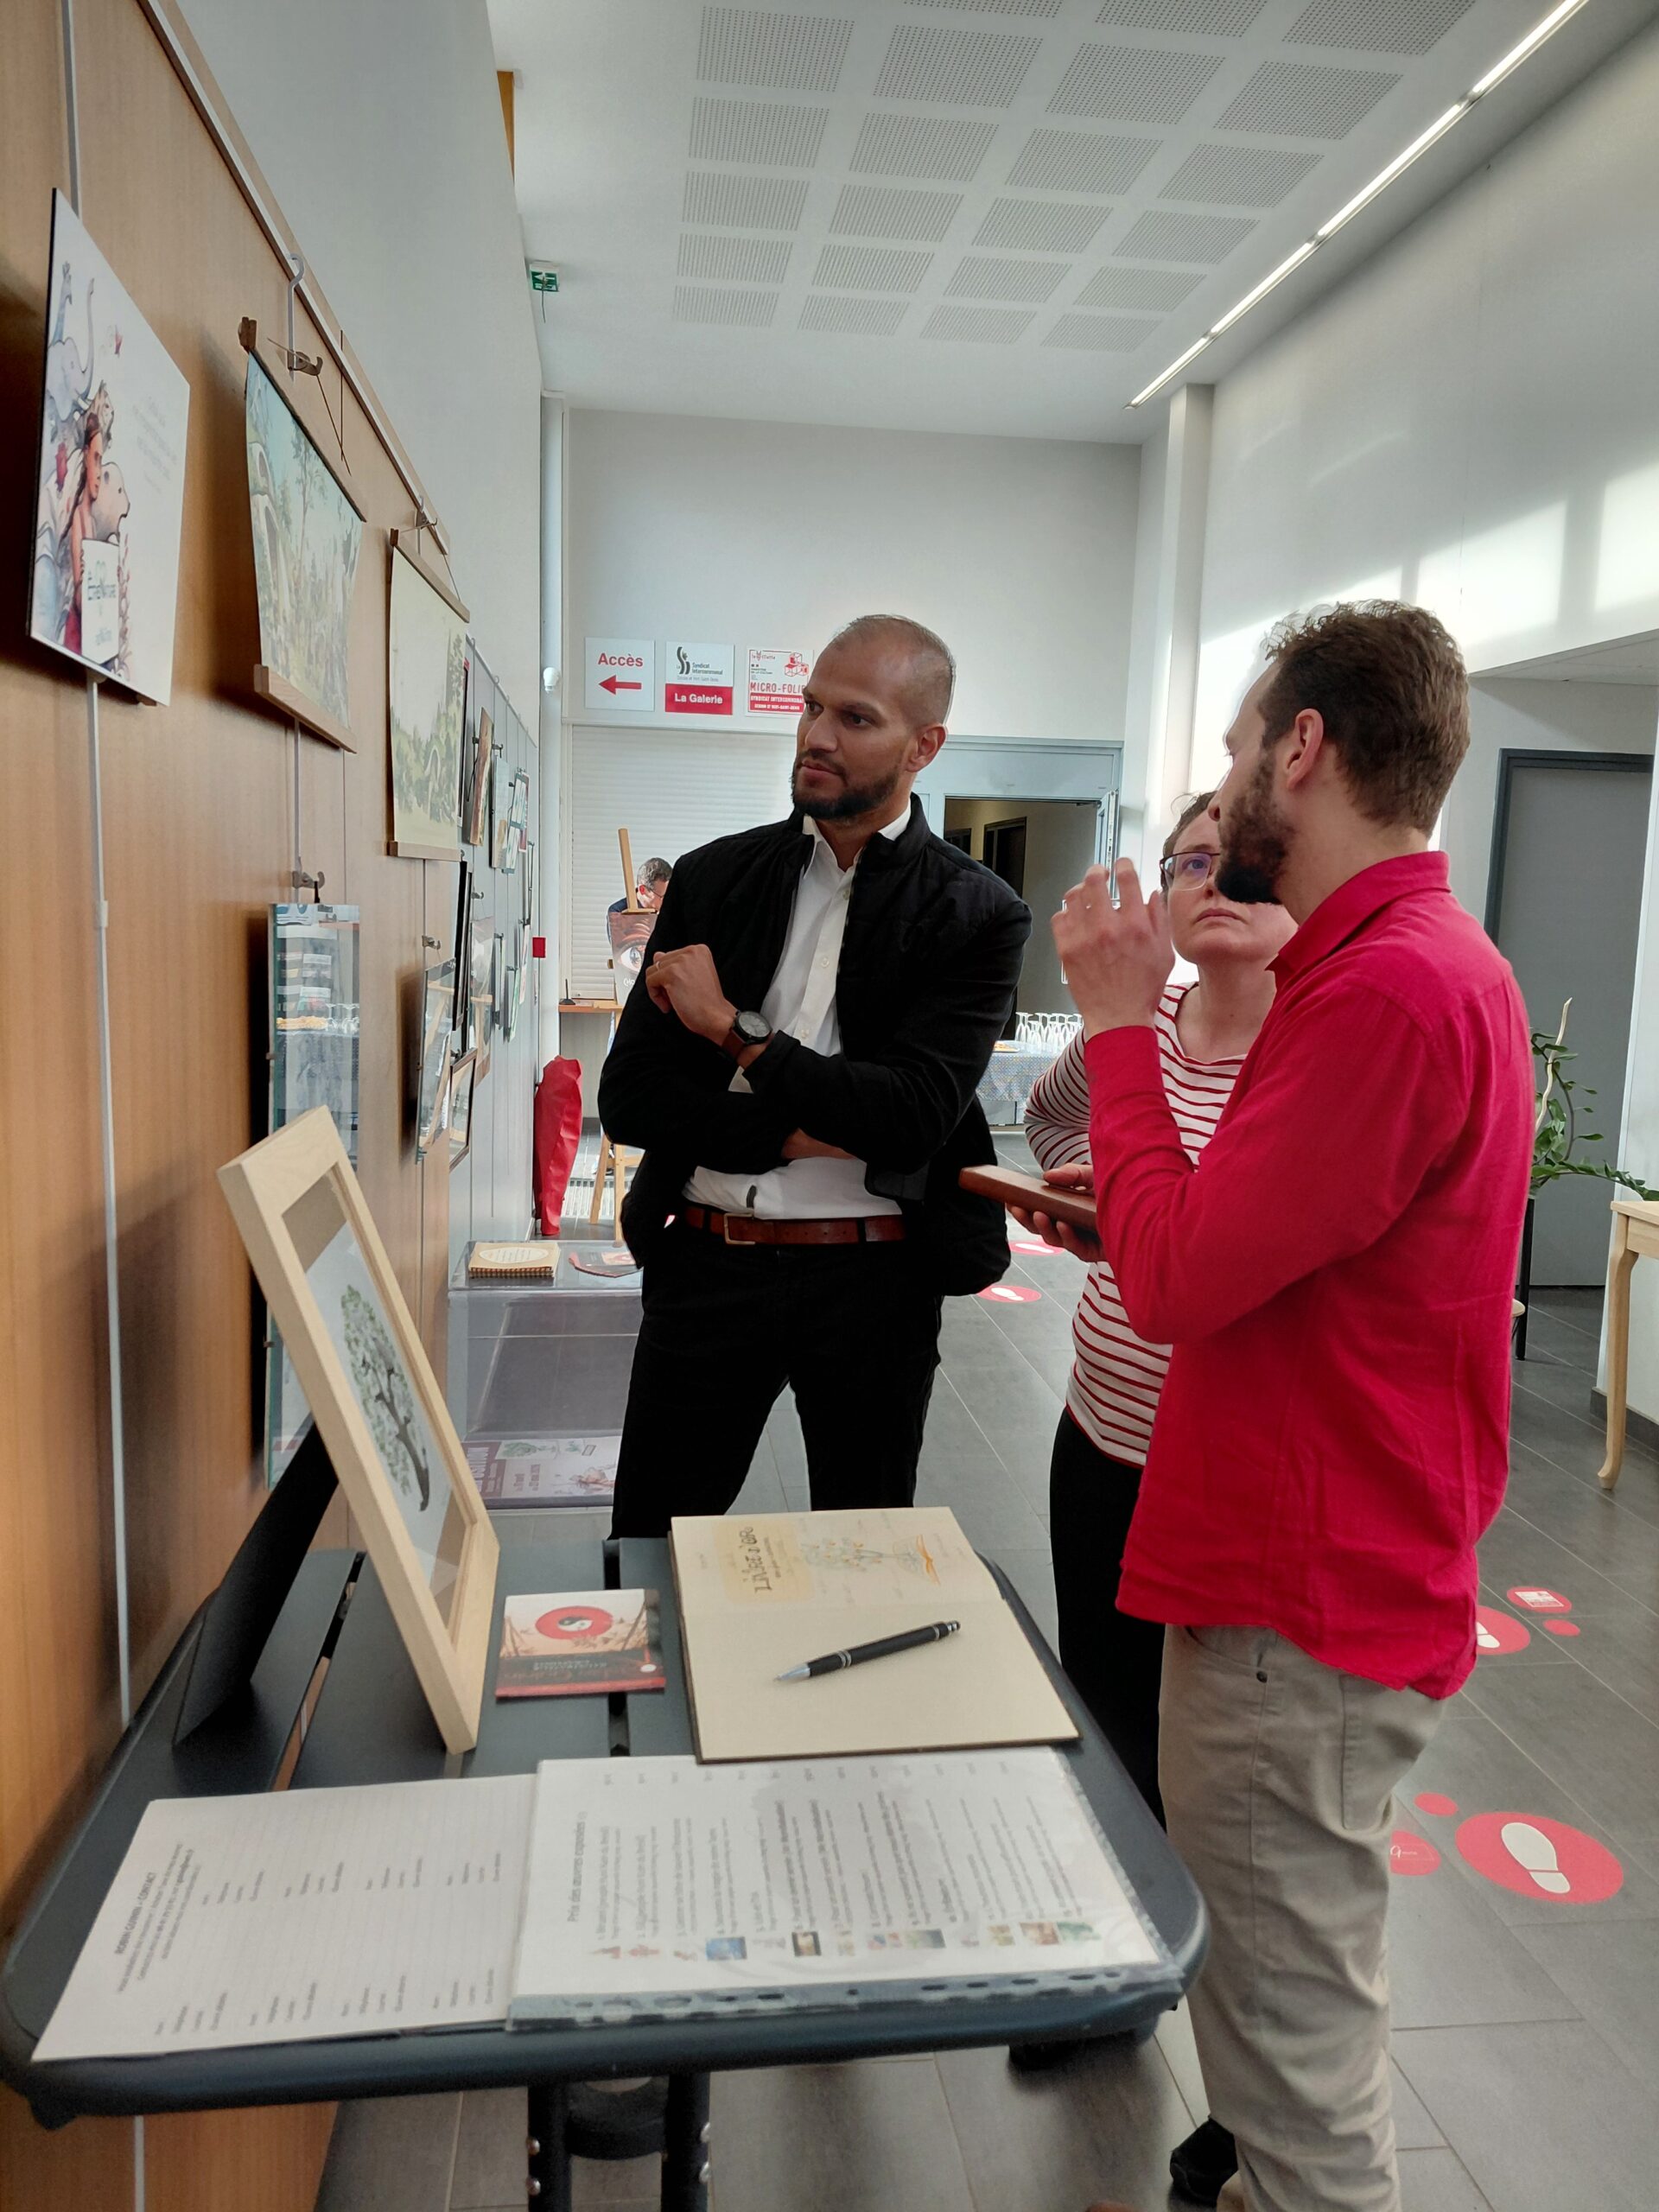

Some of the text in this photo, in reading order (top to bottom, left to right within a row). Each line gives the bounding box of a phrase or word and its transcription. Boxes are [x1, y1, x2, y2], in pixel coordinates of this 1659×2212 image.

[598, 652, 644, 667] Accès
[675, 693, 723, 704] La Galerie
